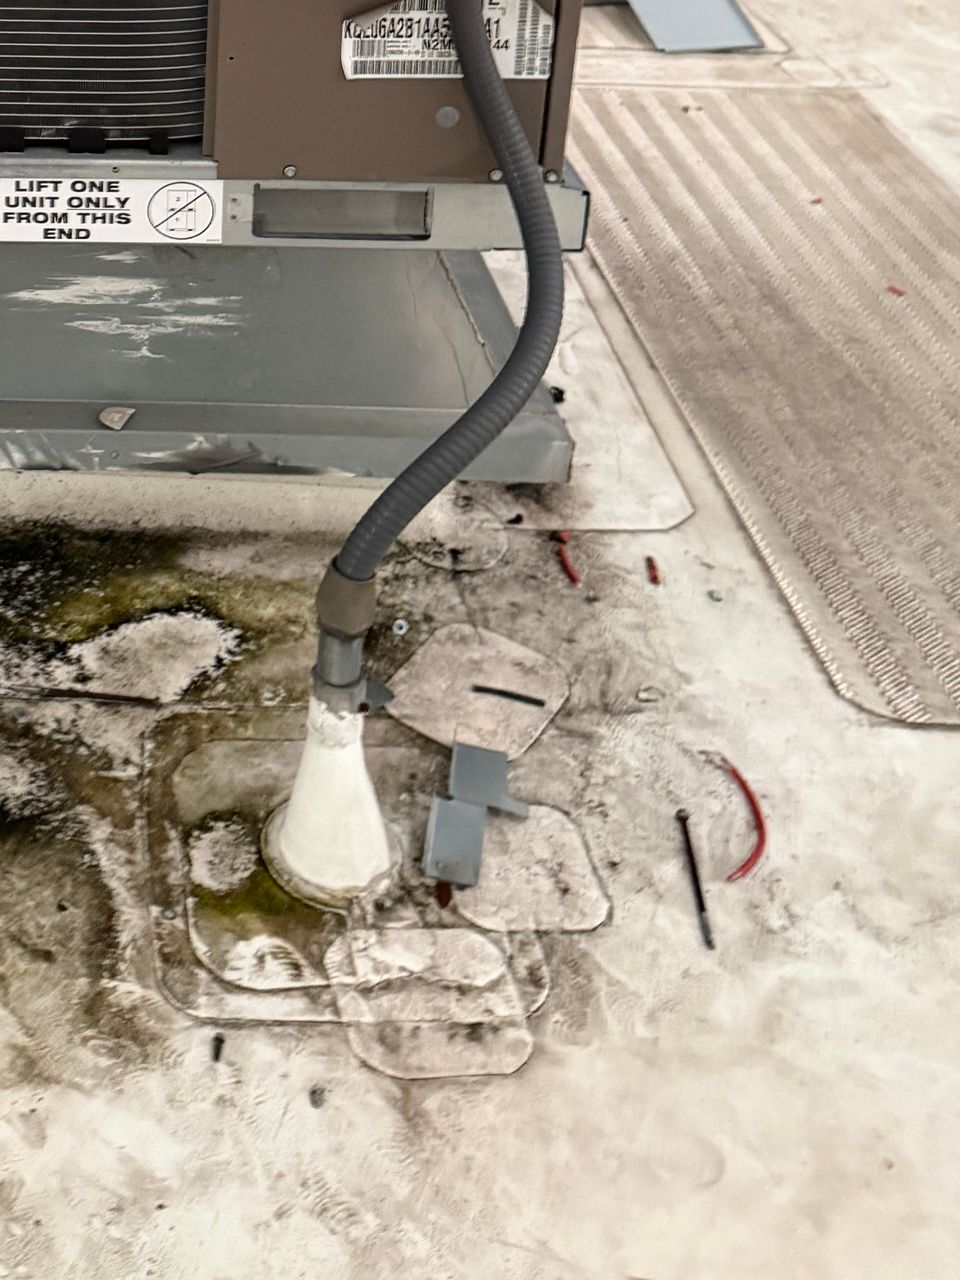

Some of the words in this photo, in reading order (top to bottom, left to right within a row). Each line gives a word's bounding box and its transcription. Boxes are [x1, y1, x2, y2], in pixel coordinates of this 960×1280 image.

[15, 181, 62, 192] LIFT
[70, 181, 120, 193] ONE
[5, 196, 58, 208] UNIT
[66, 197, 130, 208] ONLY
[3, 212, 68, 224] FROM
[78, 213, 131, 225] THIS
[43, 228, 91, 240] END
